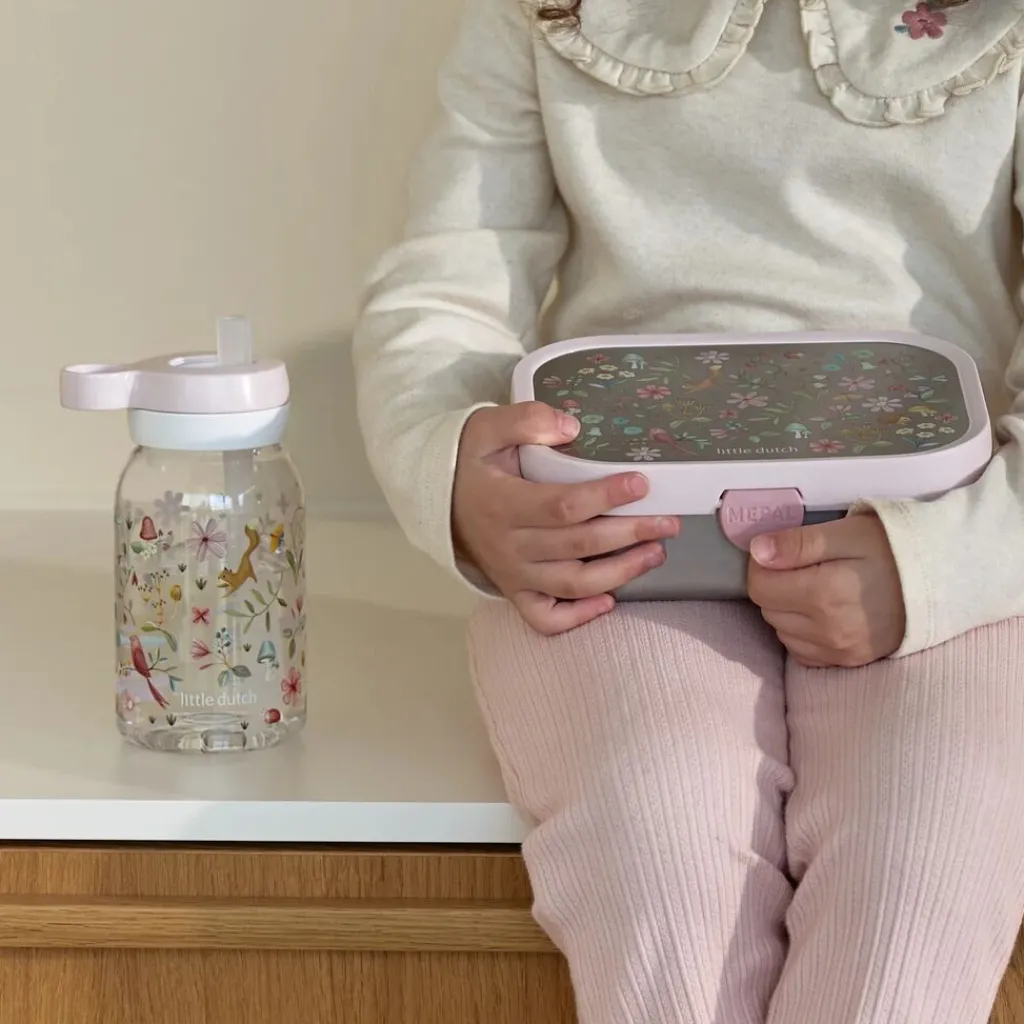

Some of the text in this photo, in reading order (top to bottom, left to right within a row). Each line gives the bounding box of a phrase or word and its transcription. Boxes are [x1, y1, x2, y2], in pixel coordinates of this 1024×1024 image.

[717, 446, 798, 455] little dutch
[727, 505, 797, 523] MEPAL
[181, 690, 257, 707] little dutch
